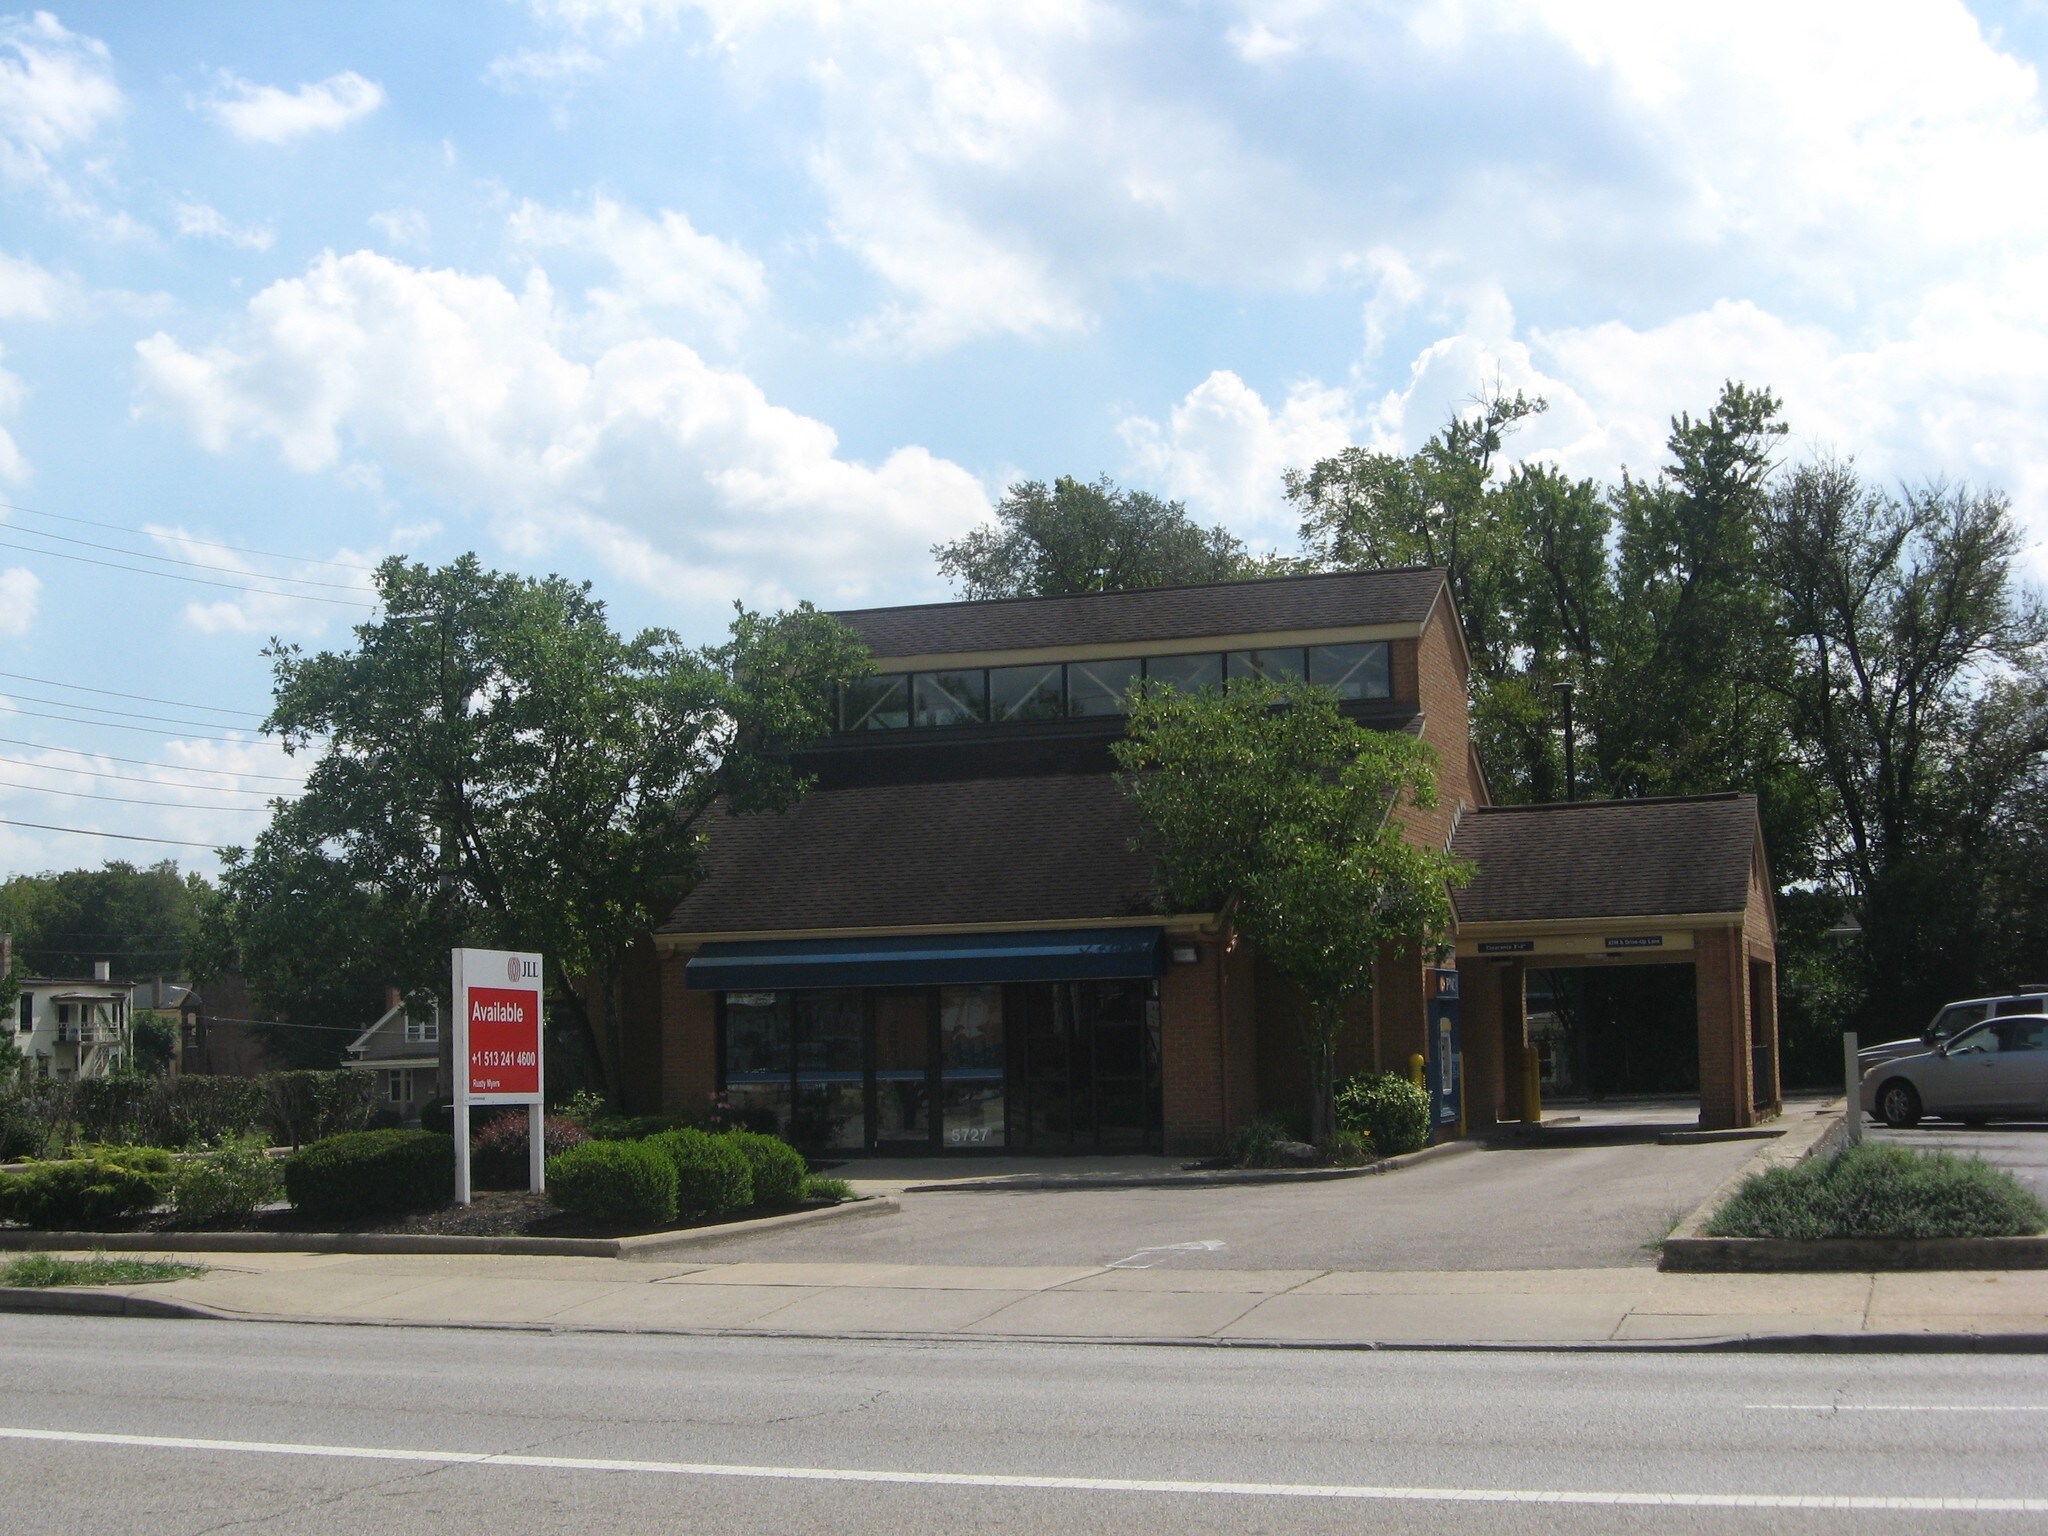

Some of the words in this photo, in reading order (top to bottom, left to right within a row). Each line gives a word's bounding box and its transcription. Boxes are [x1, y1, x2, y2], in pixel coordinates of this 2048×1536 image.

[522, 961, 538, 977] JLL
[472, 1001, 523, 1022] Available
[472, 1051, 481, 1066] +1
[484, 1051, 499, 1066] 513
[501, 1051, 514, 1066] 241
[517, 1051, 536, 1066] 4600
[472, 1079, 486, 1090] Rusty
[951, 1127, 990, 1142] 5727
